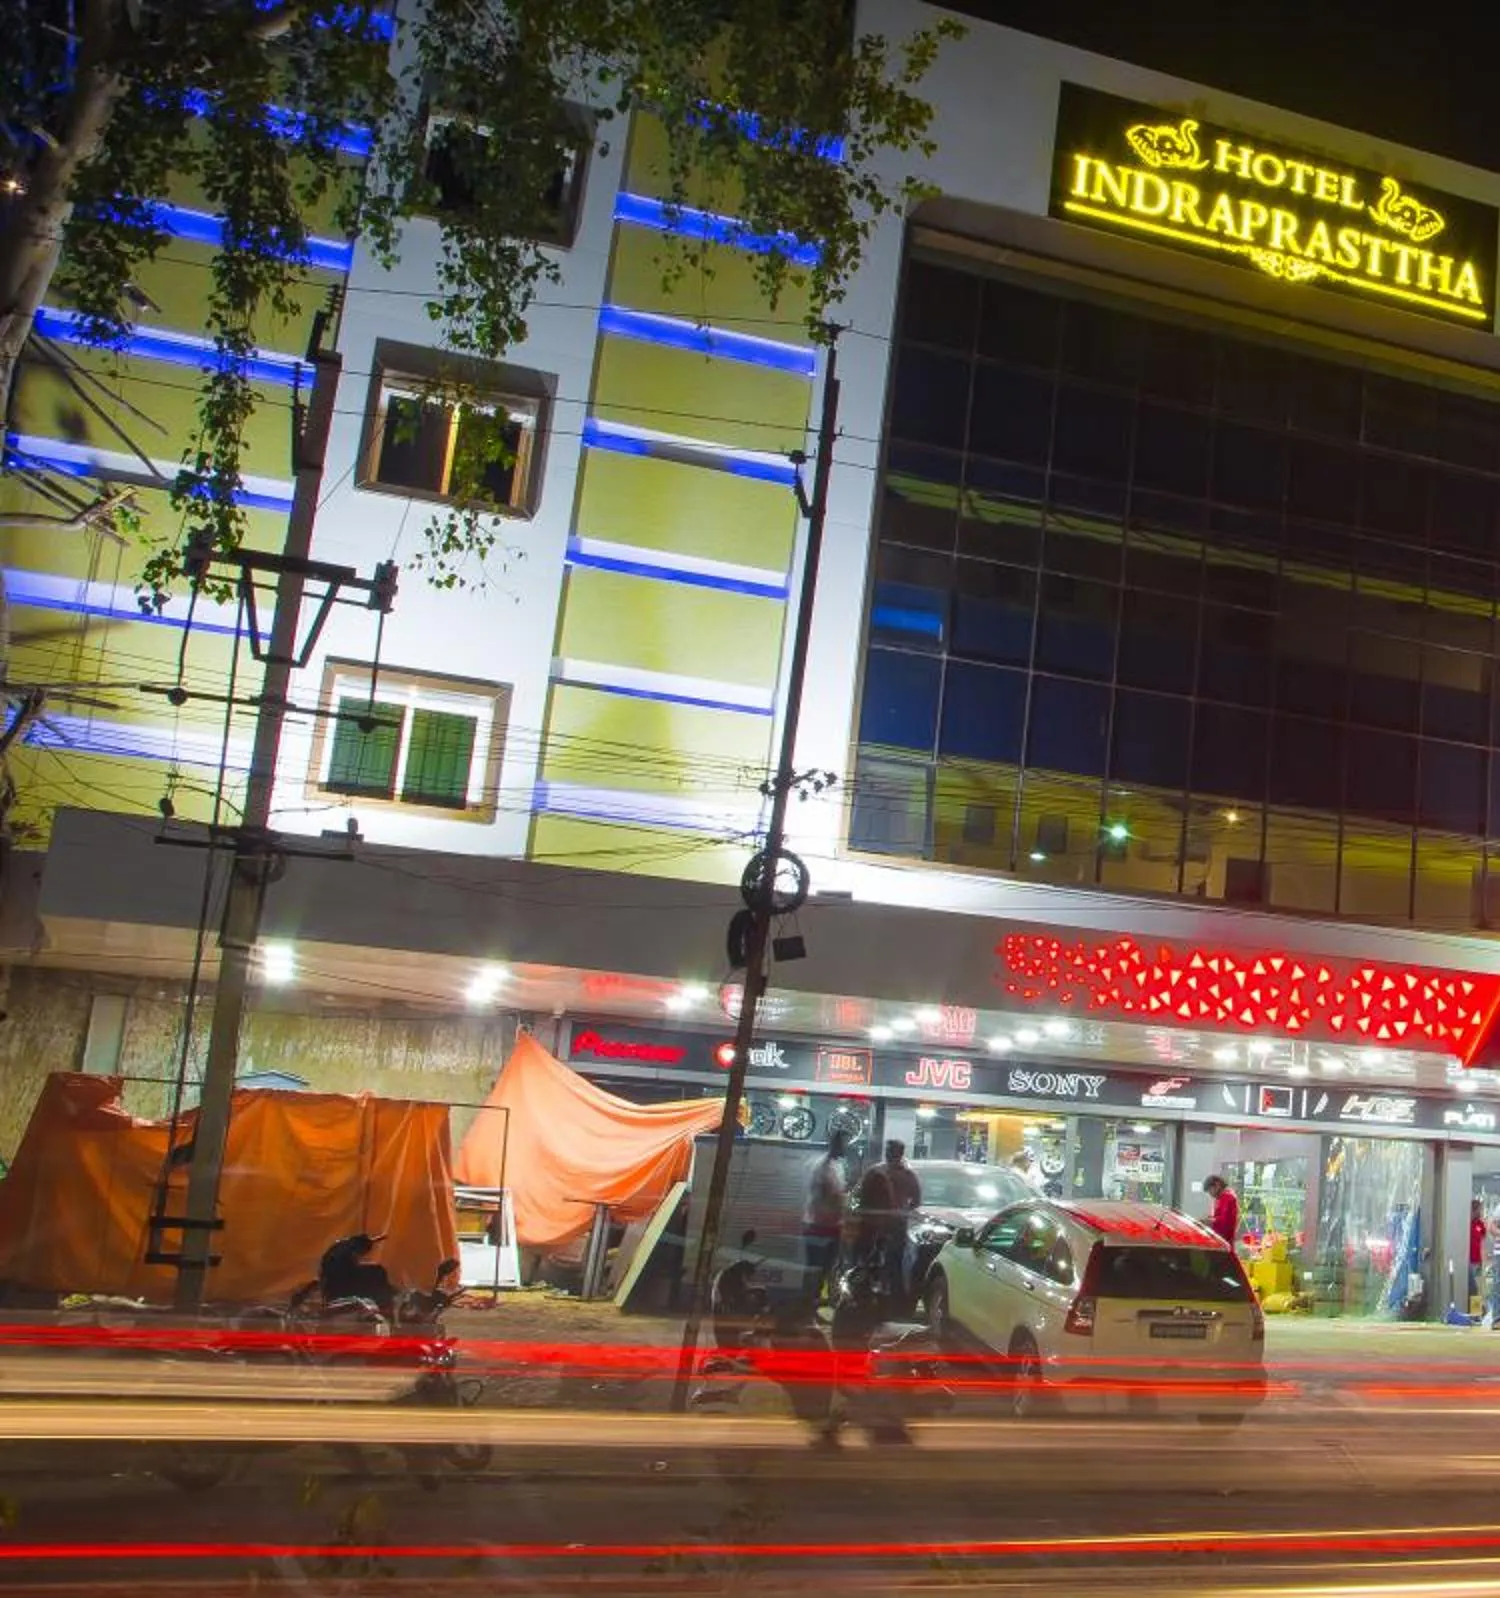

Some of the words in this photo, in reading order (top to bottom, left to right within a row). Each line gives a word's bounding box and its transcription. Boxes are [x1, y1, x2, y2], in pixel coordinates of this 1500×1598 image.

[1213, 138, 1365, 211] HOTEL
[1071, 152, 1483, 304] INDRAPRASTTHA
[906, 1057, 972, 1090] JVC
[1008, 1069, 1107, 1099] SONY
